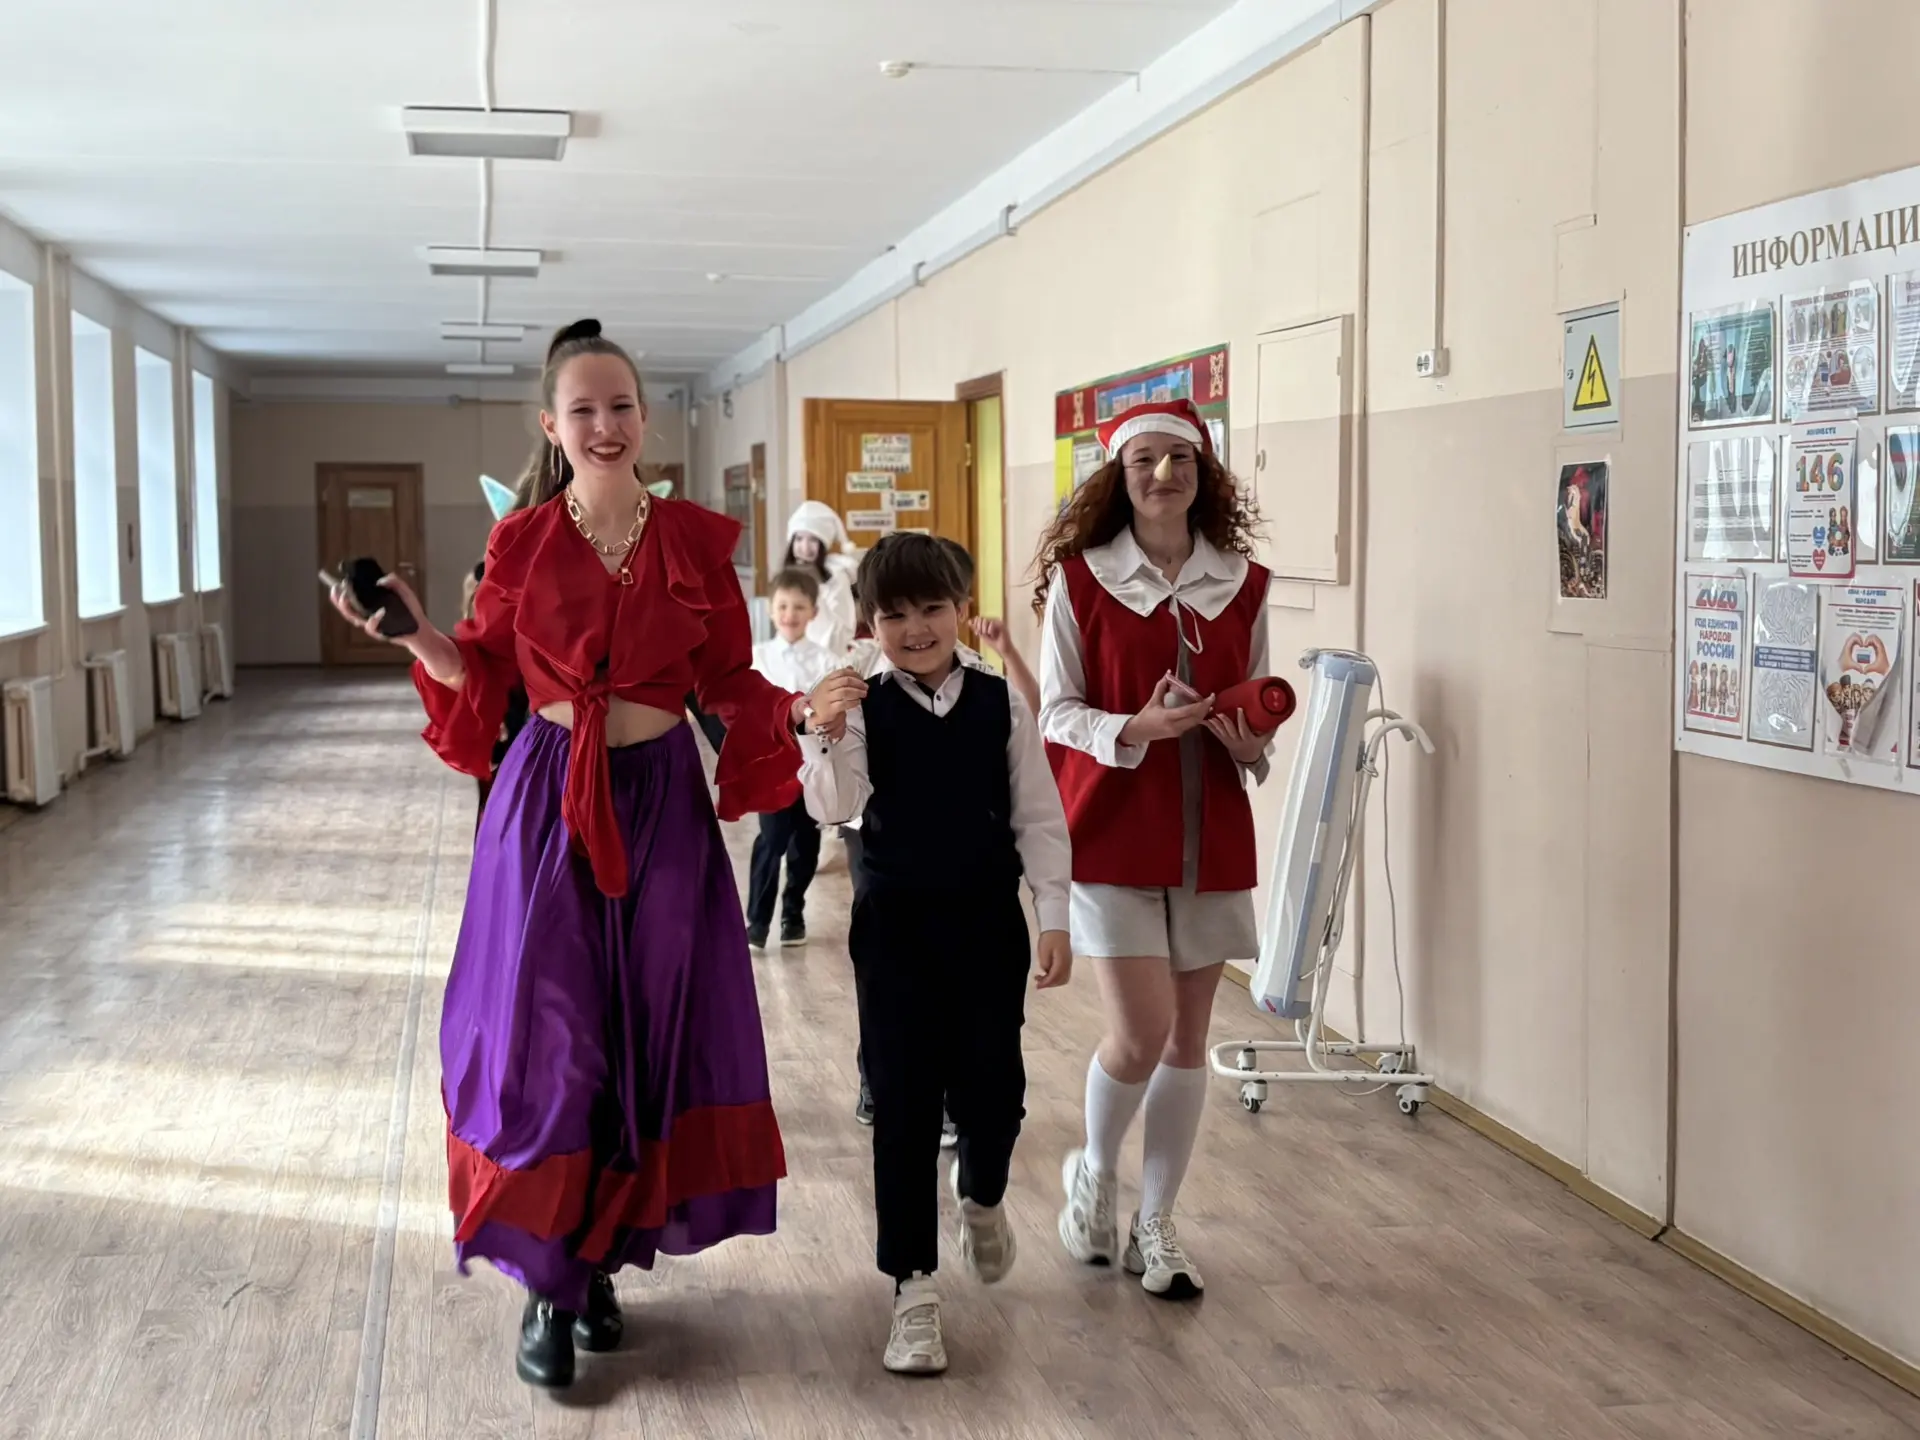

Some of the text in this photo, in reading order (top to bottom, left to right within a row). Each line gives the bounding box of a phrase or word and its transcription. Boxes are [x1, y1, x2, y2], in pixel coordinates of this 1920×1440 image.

[1732, 203, 1920, 279] ИНФОРМАЦИ
[1796, 452, 1844, 492] 146
[1694, 617, 1739, 631] ГОД ЕДИНСТВА
[1699, 630, 1732, 643] НАРОДОВ
[1696, 641, 1735, 660] РОССИИ
